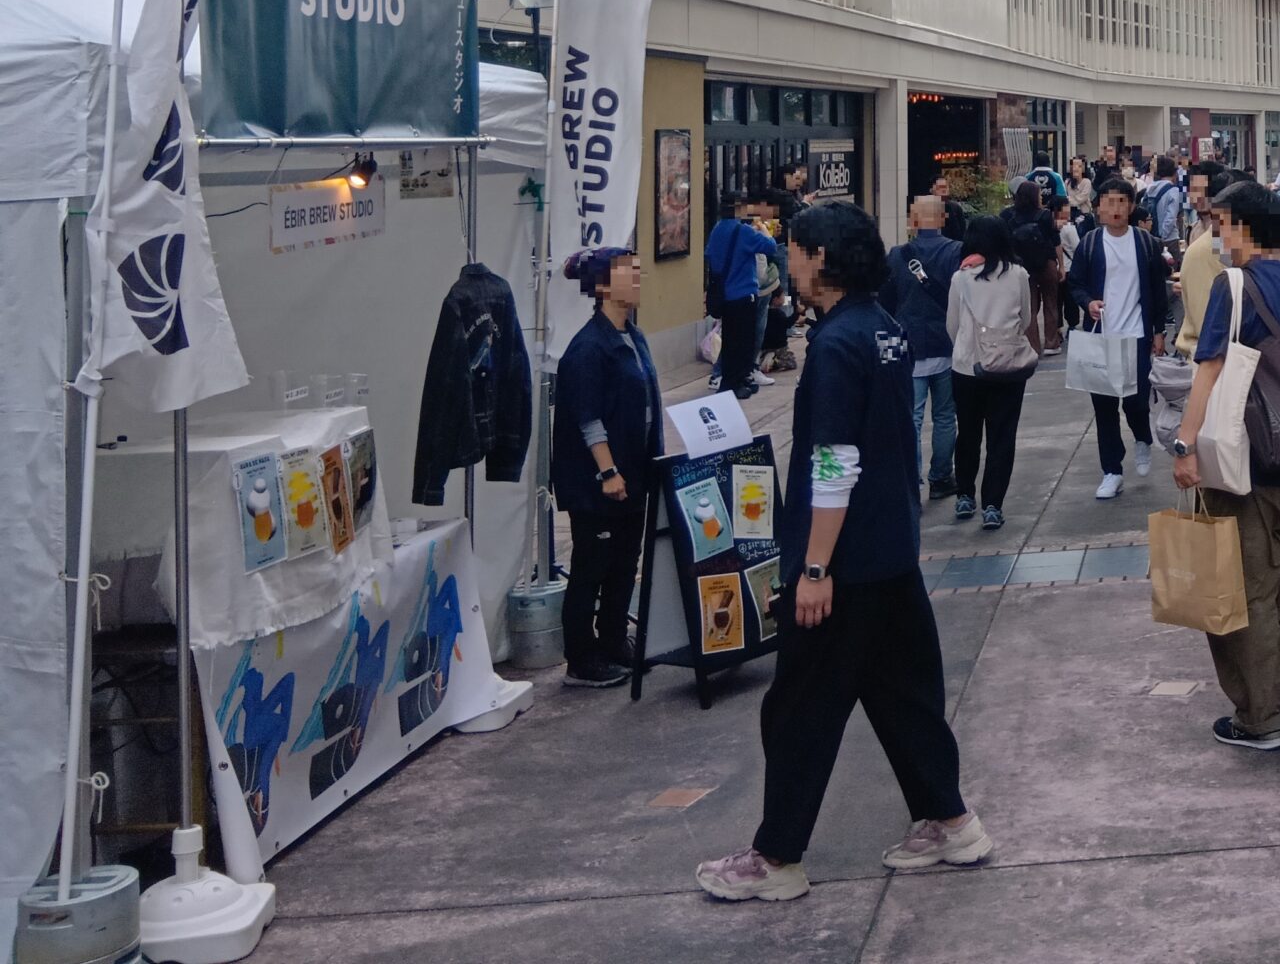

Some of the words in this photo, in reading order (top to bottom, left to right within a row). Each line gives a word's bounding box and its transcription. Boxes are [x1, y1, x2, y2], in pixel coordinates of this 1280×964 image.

[284, 206, 307, 229] ÉBIR
[310, 204, 337, 225] BREW
[340, 199, 374, 220] STUDIO
[582, 87, 619, 247] STUDIO
